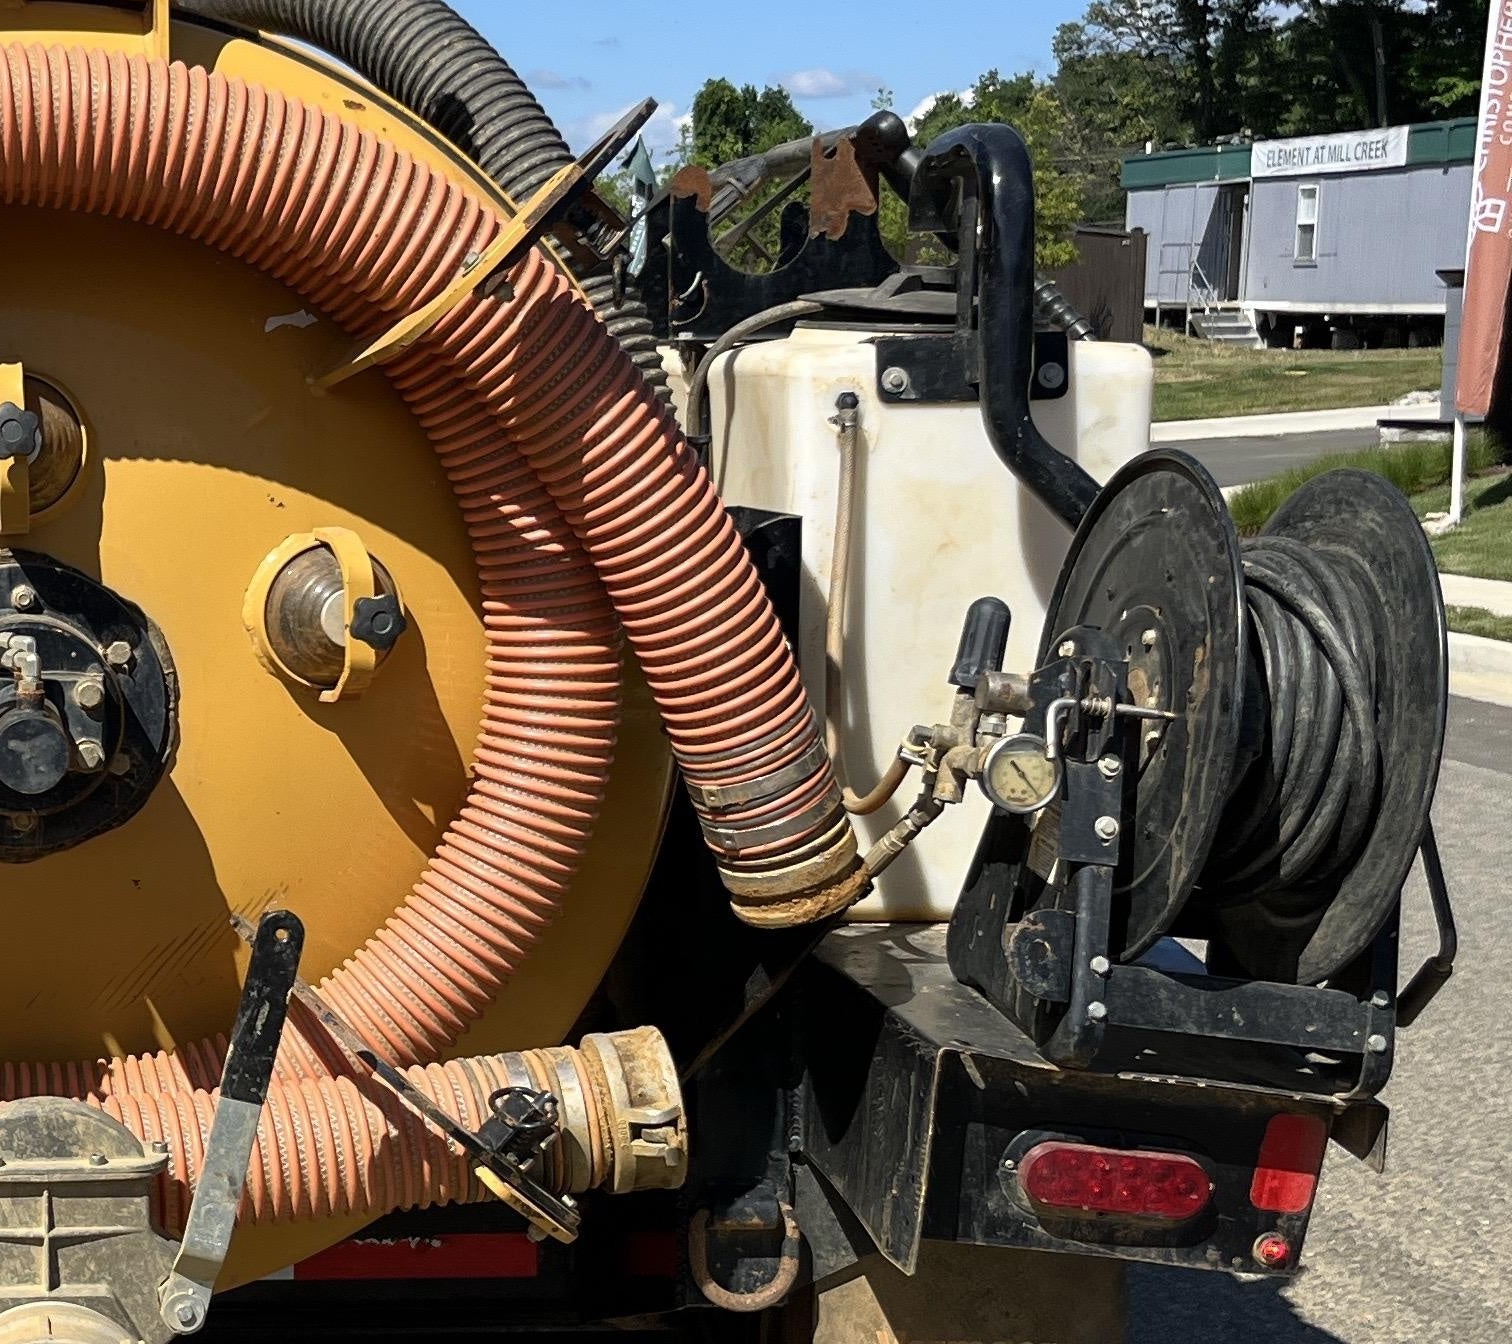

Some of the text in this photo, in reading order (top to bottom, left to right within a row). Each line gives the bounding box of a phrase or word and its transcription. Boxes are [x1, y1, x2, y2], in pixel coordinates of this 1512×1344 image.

[1266, 139, 1388, 168] ELEMENT AT MILL CREEK
